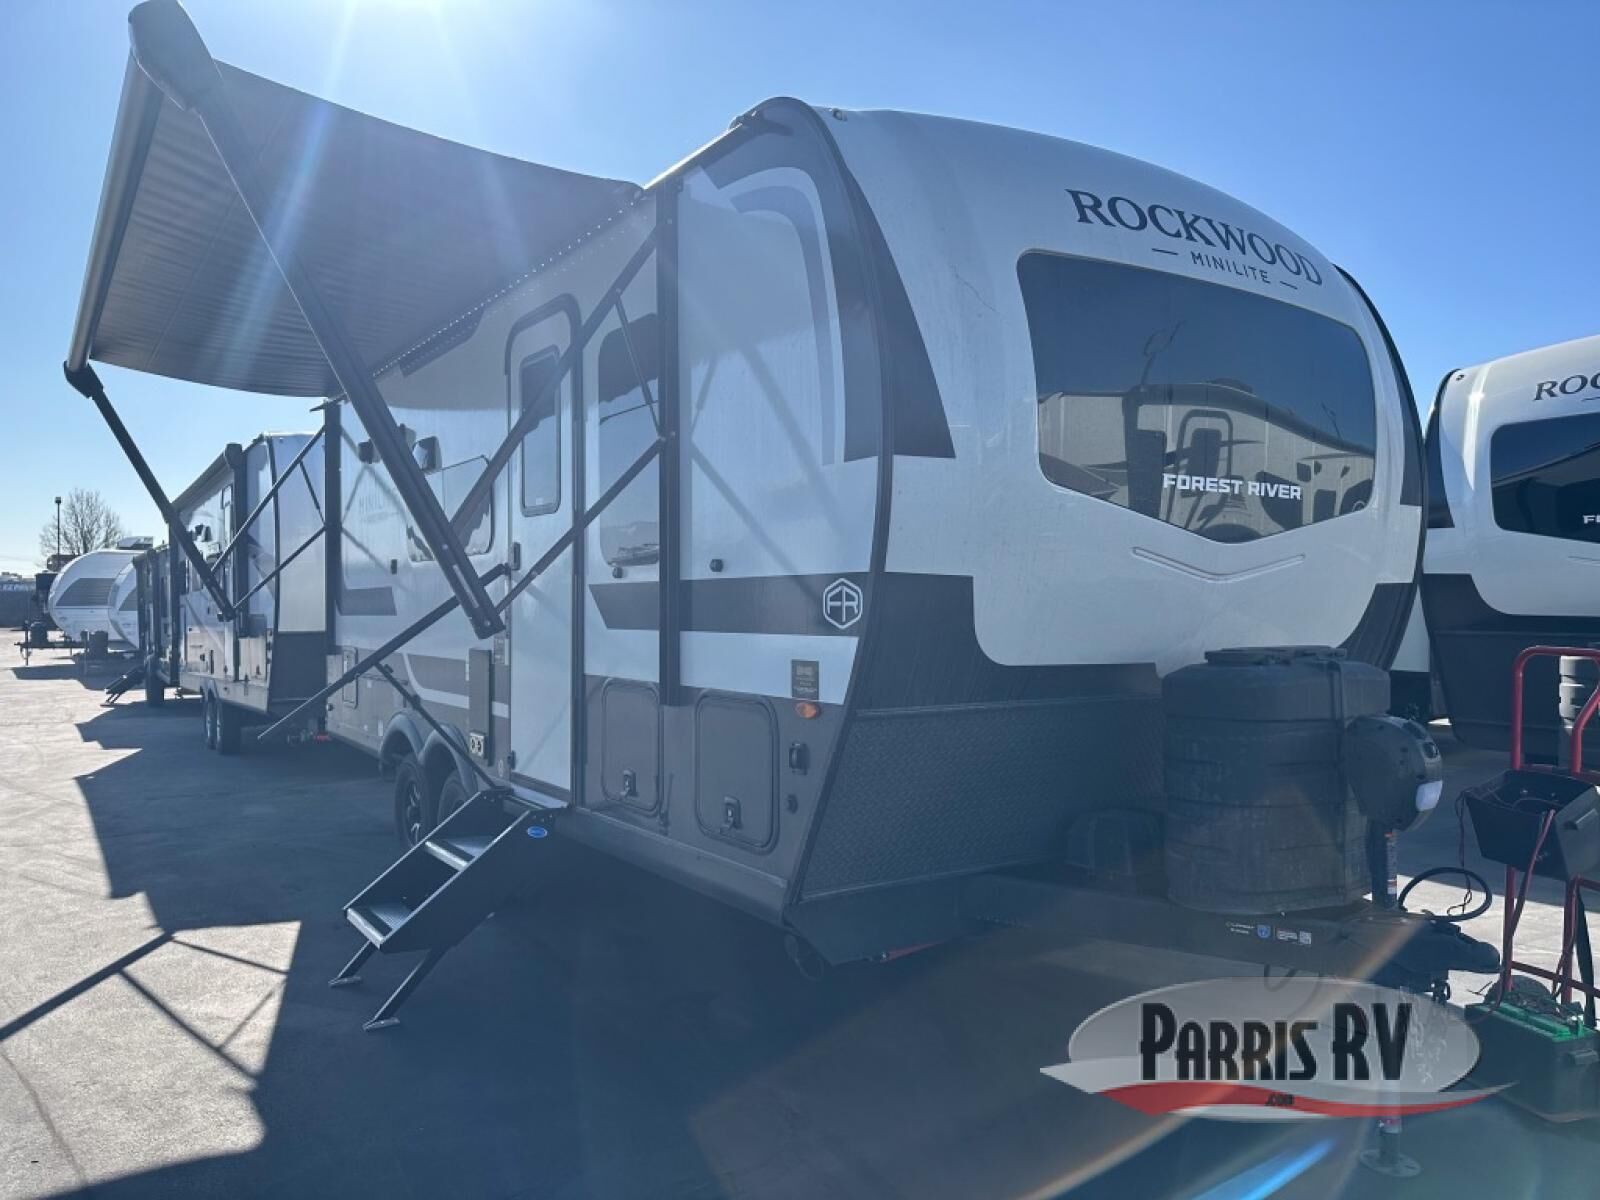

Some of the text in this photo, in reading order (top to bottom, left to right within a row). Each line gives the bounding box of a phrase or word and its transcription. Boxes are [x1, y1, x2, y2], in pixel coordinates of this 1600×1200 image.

[1065, 188, 1322, 285] ROCKWOOD
[1190, 251, 1271, 284] MINILITE
[1162, 473, 1301, 500] FOREST RIVER
